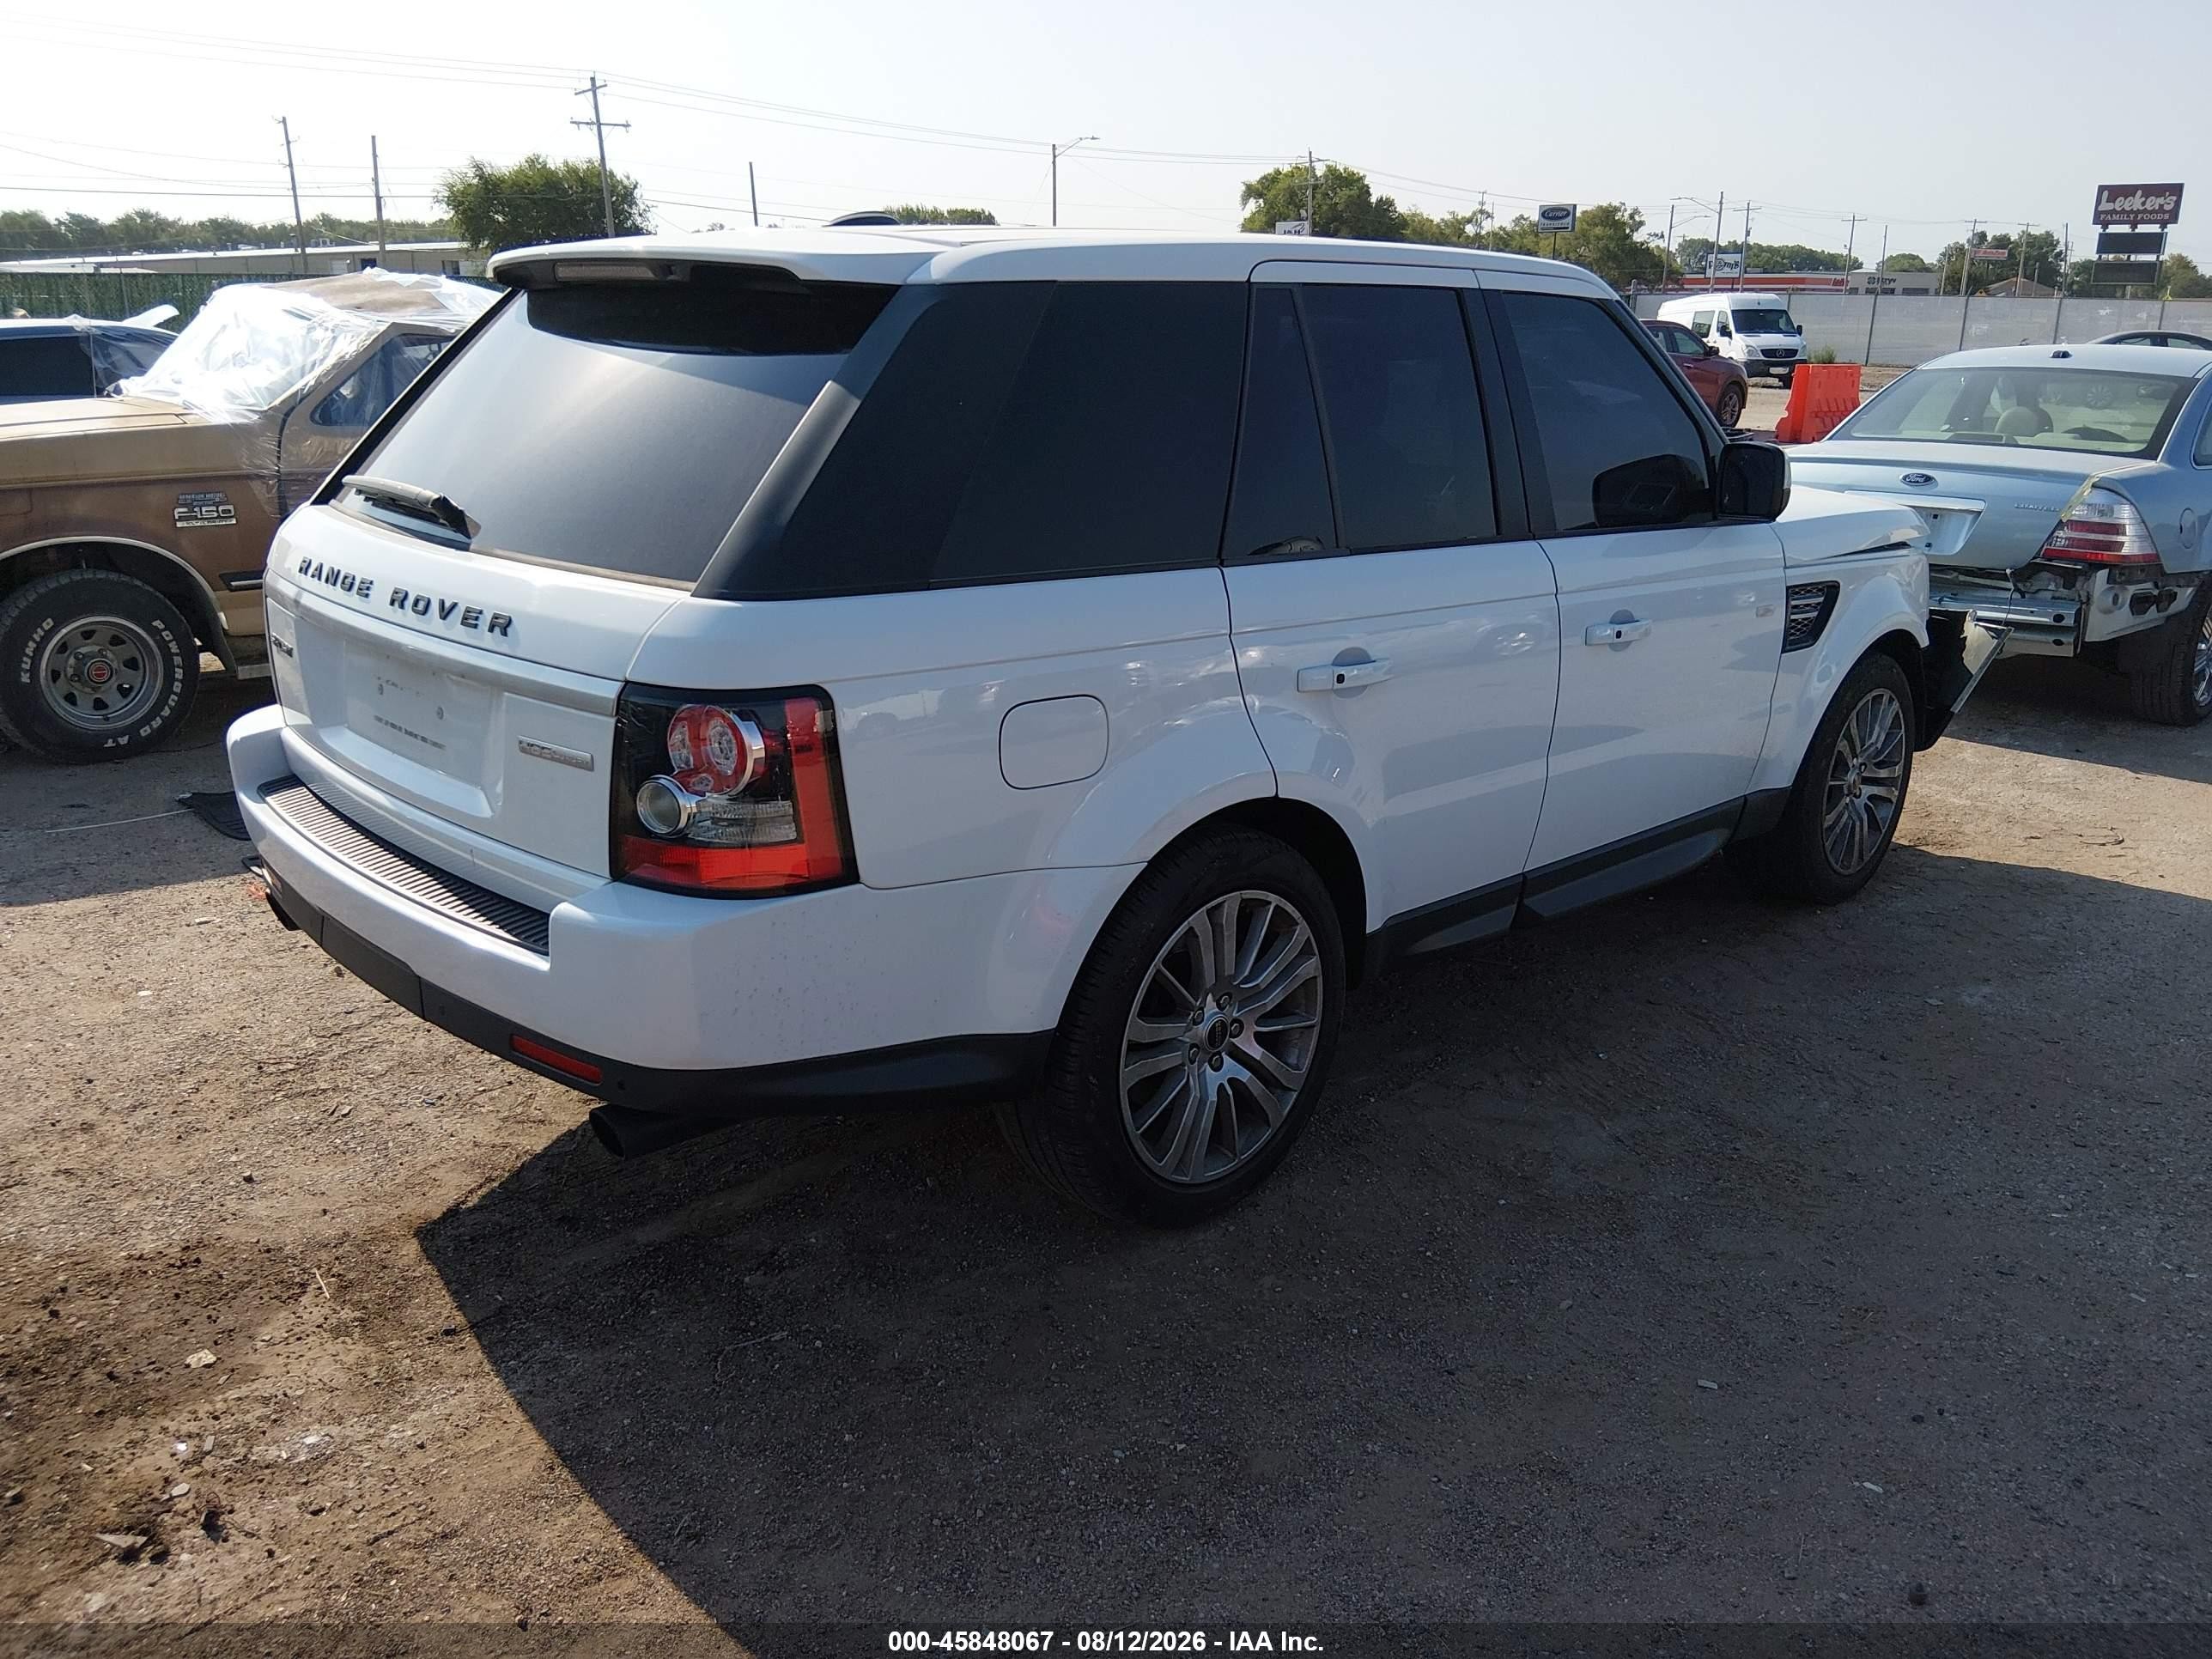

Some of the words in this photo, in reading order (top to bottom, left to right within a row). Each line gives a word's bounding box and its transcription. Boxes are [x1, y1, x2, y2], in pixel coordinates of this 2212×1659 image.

[2098, 190, 2178, 211] Leeker's
[174, 505, 234, 520] F-150
[298, 556, 374, 599] RANGE
[389, 586, 513, 637] ROVER
[20, 617, 55, 684] KUMHO
[139, 619, 184, 737] POWERGUARD
[103, 734, 131, 747] AT
